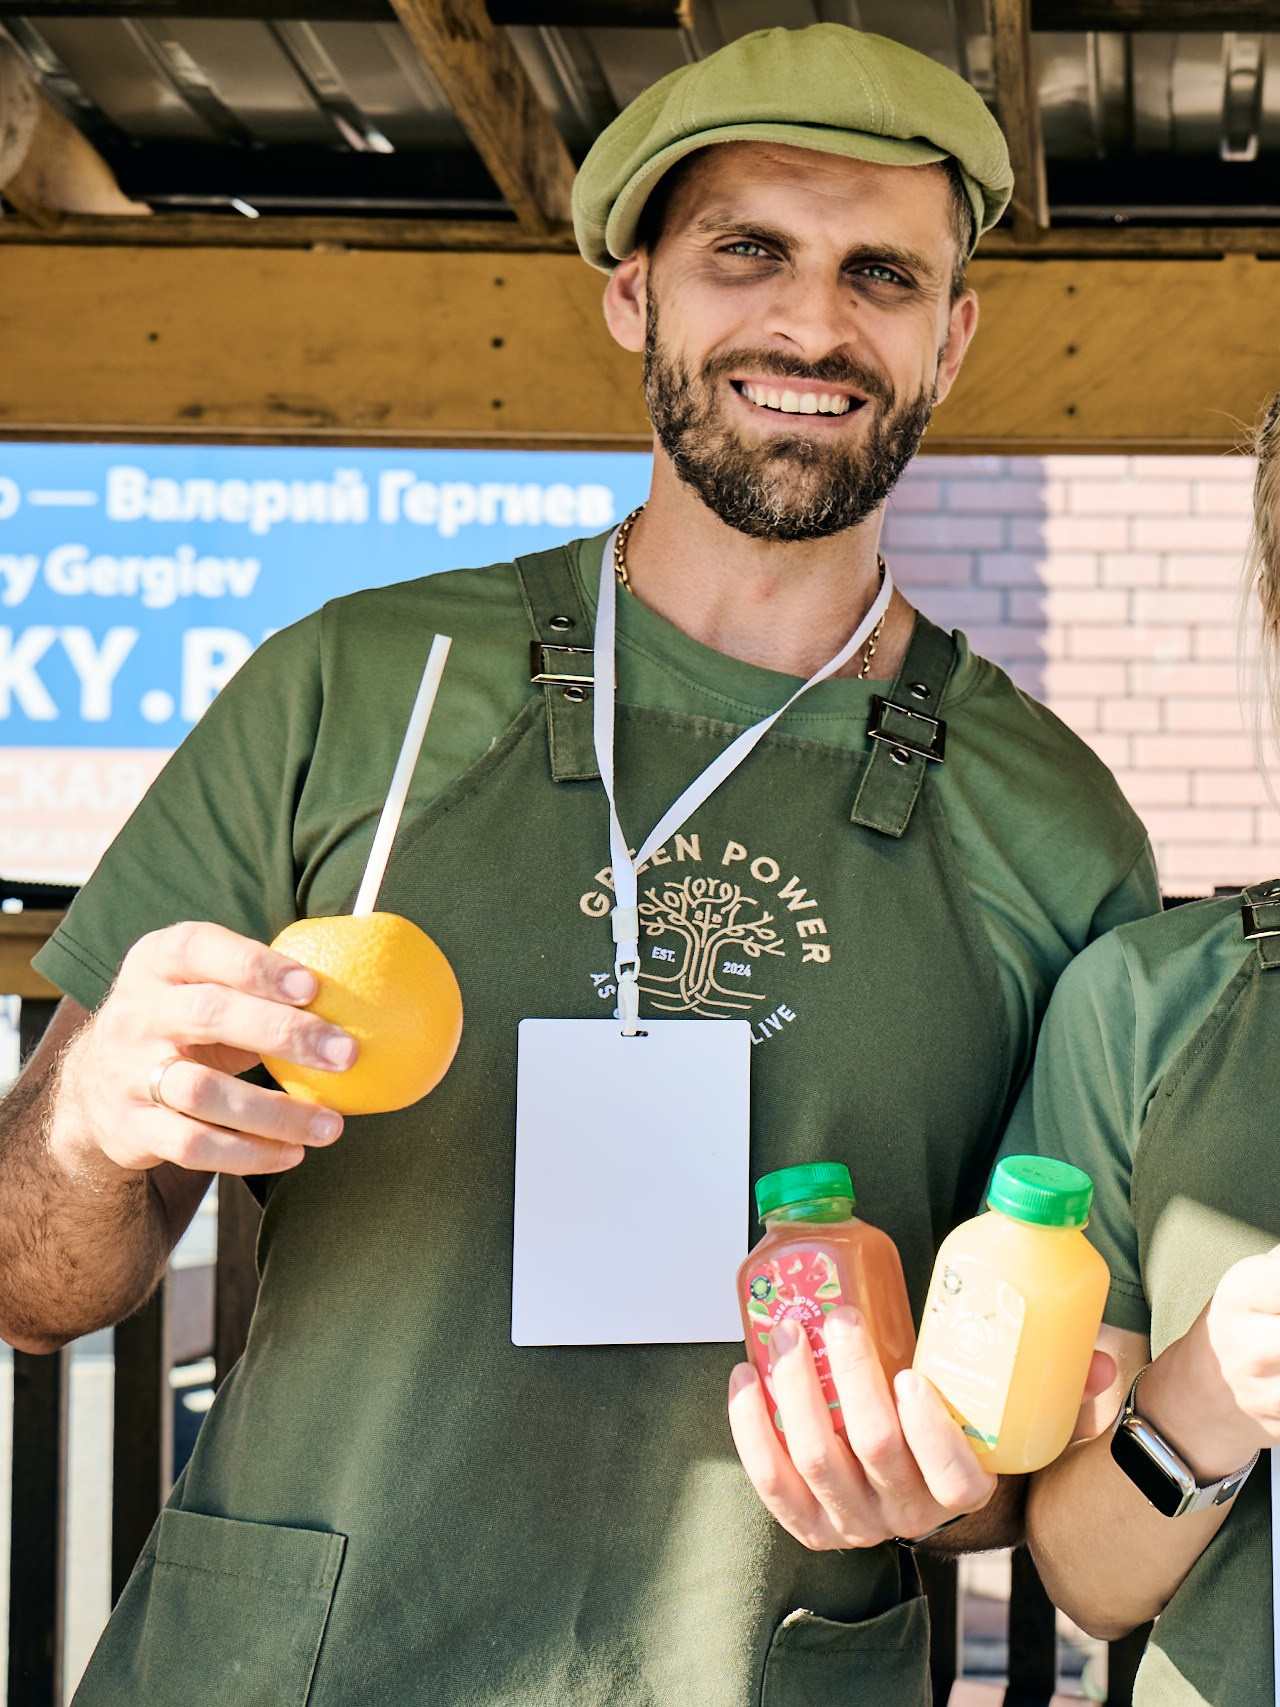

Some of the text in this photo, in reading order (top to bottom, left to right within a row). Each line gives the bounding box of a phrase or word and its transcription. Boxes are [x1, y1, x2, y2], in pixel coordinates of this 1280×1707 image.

[107, 466, 368, 535] Валерий
[378, 470, 614, 537] Гергиев
[44, 543, 261, 609] Gergiev
[721, 840, 831, 964] POWER
[651, 946, 676, 963] EST.
[722, 961, 752, 977] 2024
